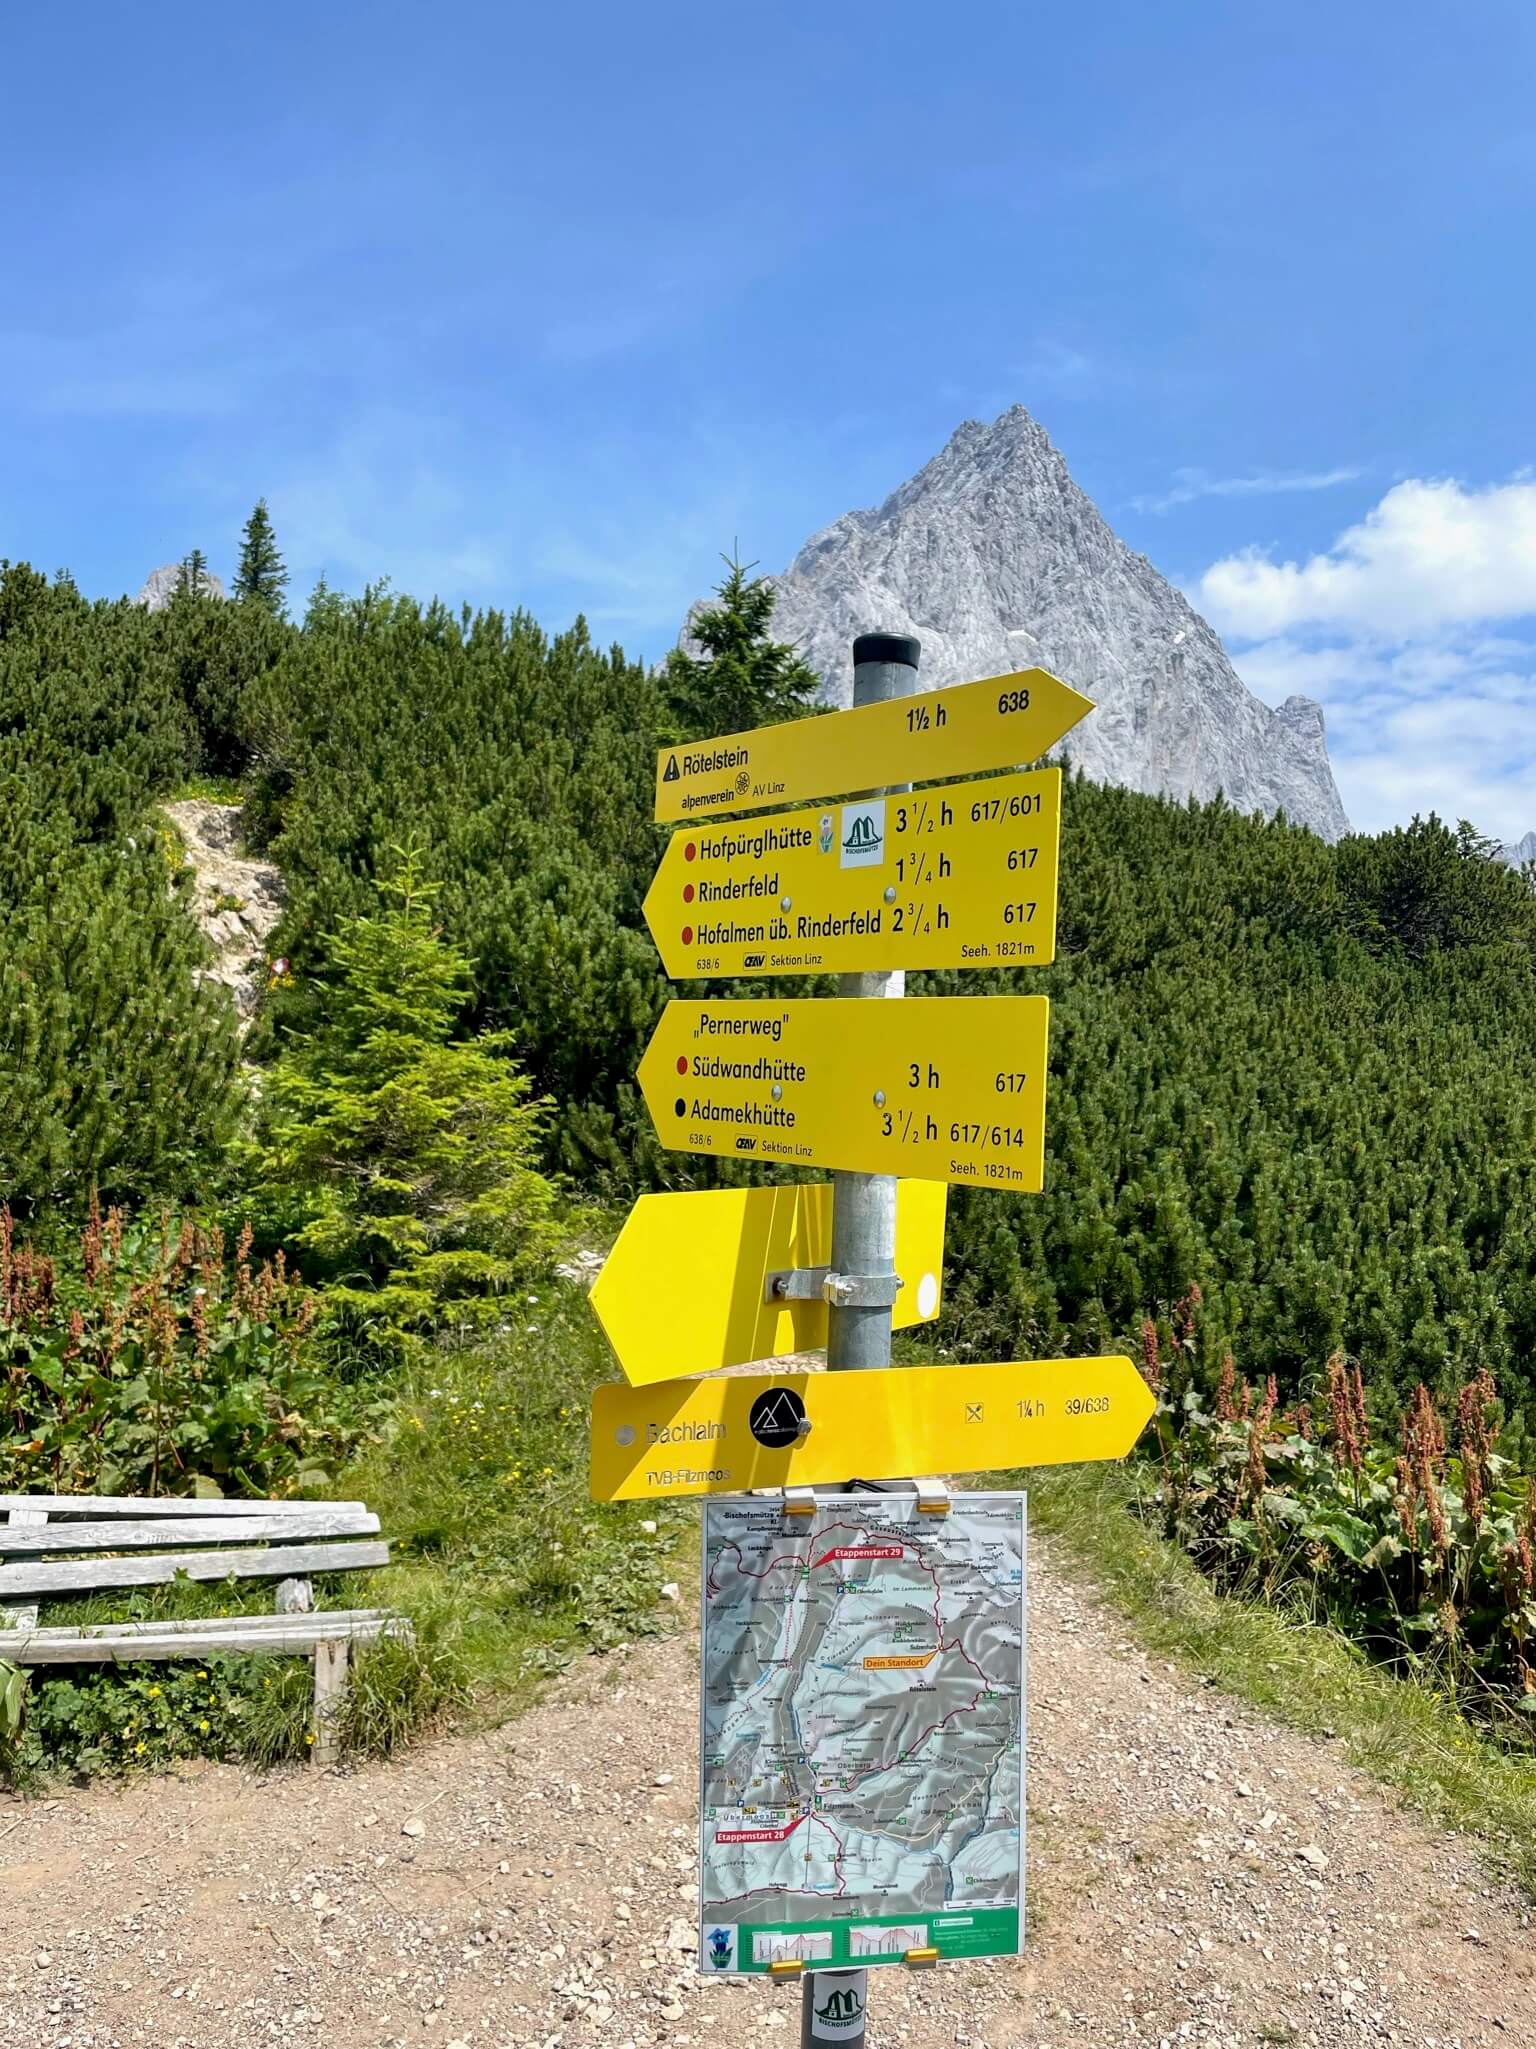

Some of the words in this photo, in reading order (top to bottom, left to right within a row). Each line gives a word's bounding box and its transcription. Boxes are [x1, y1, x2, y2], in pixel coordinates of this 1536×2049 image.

[683, 746, 749, 776] Rötelstein
[935, 703, 946, 727] h
[998, 689, 1030, 715] 638
[681, 787, 735, 810] alpenverein
[752, 783, 766, 797] AV
[767, 781, 785, 795] Linz
[700, 827, 812, 863] Hofpürglhütte
[941, 800, 953, 827] h
[971, 793, 1041, 824] 617/601
[699, 872, 779, 903] Rinderfeld
[939, 852, 951, 878] h
[1007, 847, 1039, 871] 617
[697, 921, 764, 945] Hofalmen
[769, 917, 792, 941] üb.
[797, 908, 881, 939] Rinderfeld
[937, 903, 949, 929] h
[1004, 902, 1037, 924] 617
[696, 958, 720, 970] 638/6
[770, 954, 802, 967] Sektion
[804, 953, 823, 965] Linz
[961, 943, 991, 958] Seeh.
[996, 941, 1035, 956] 1821m
[692, 1055, 806, 1082] Südwandhütte
[908, 1063, 920, 1088] 3
[928, 1063, 940, 1089] h
[995, 1072, 1026, 1093] 617
[690, 1099, 796, 1129] Adamekhütte
[926, 1114, 938, 1141] h
[950, 1123, 1024, 1148] 617/614
[688, 1133, 712, 1147] 638/6
[761, 1140, 793, 1155] Sektion
[795, 1143, 813, 1157] Linz
[950, 1159, 979, 1176] Seeh.
[983, 1164, 1023, 1180] 1821m
[646, 1420, 727, 1444] Bachlalm
[1036, 1399, 1045, 1417] h
[1064, 1396, 1110, 1416] 39/638
[834, 1549, 889, 1558] Etappenstart
[890, 1548, 901, 1556] 29
[866, 1660, 886, 1668] Dein
[887, 1659, 924, 1667] Standort
[717, 1832, 773, 1842] Etappenstart
[774, 1831, 785, 1839] 28
